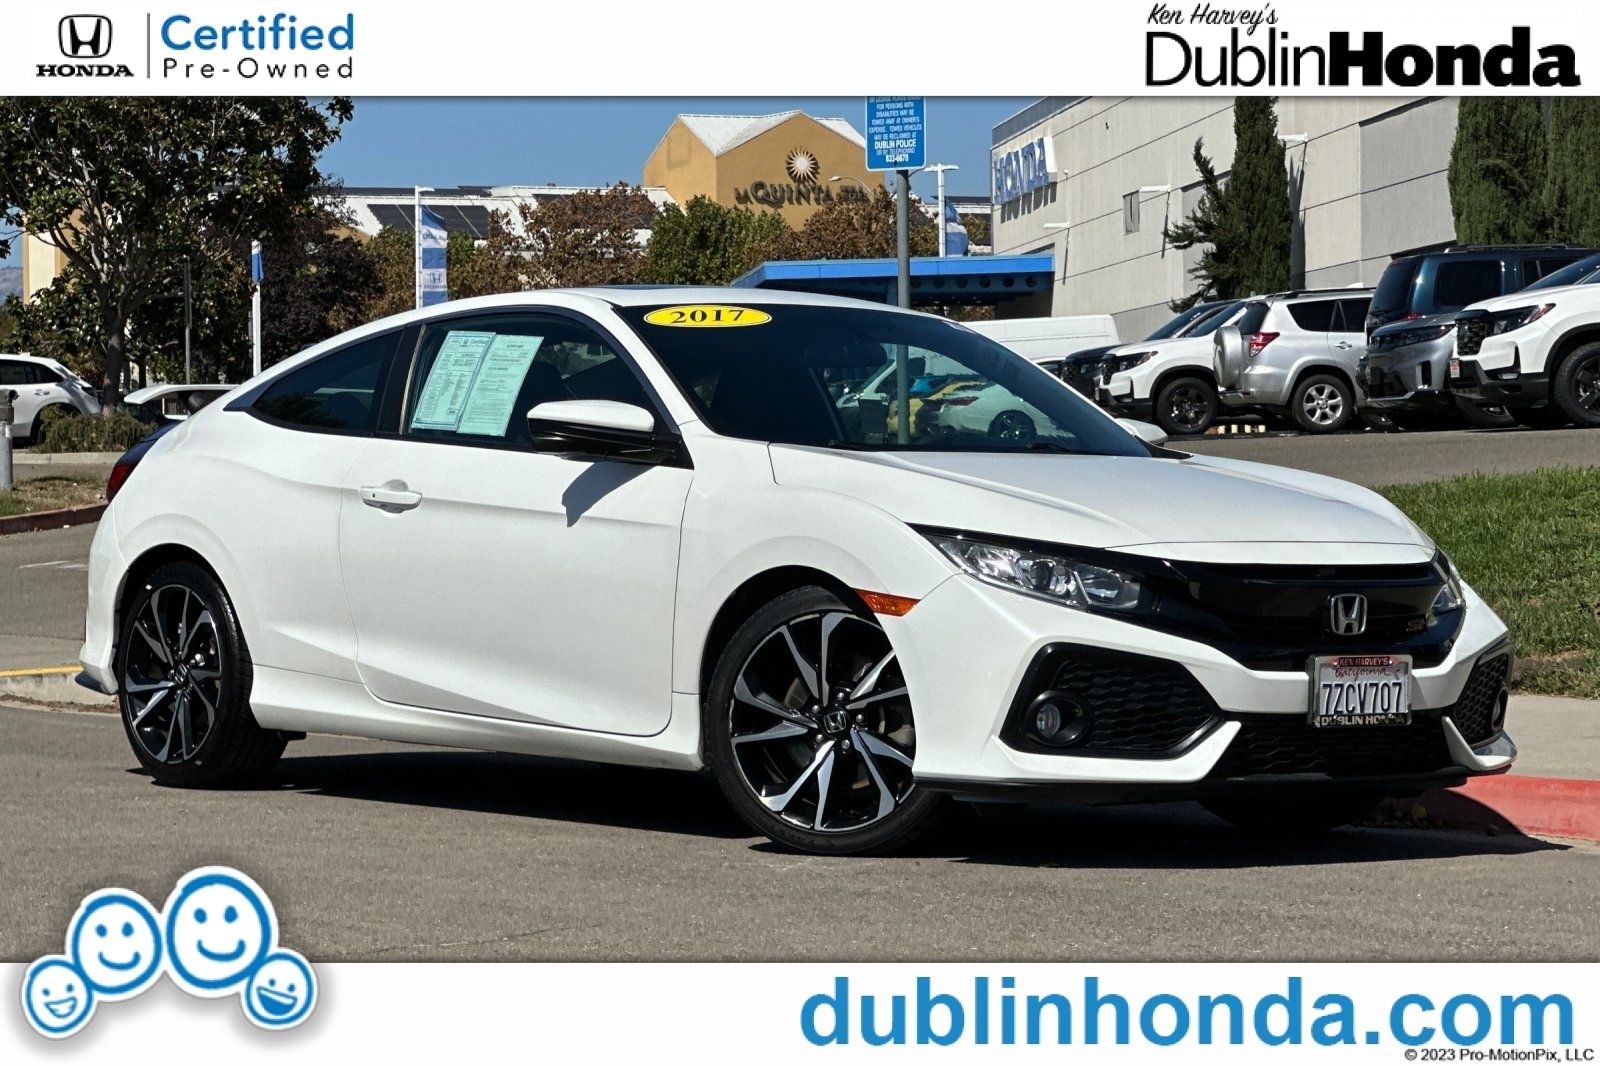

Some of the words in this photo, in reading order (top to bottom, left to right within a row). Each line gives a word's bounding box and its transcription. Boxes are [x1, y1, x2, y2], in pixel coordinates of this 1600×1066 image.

[874, 140, 895, 149] DUBLIN
[896, 139, 917, 148] POLICE
[992, 137, 1049, 206] HONDA
[751, 180, 834, 205] QUINTA
[669, 309, 745, 324] 2017
[1355, 658, 1389, 666] HARVEY'S
[1322, 682, 1403, 714] 7ZCV707
